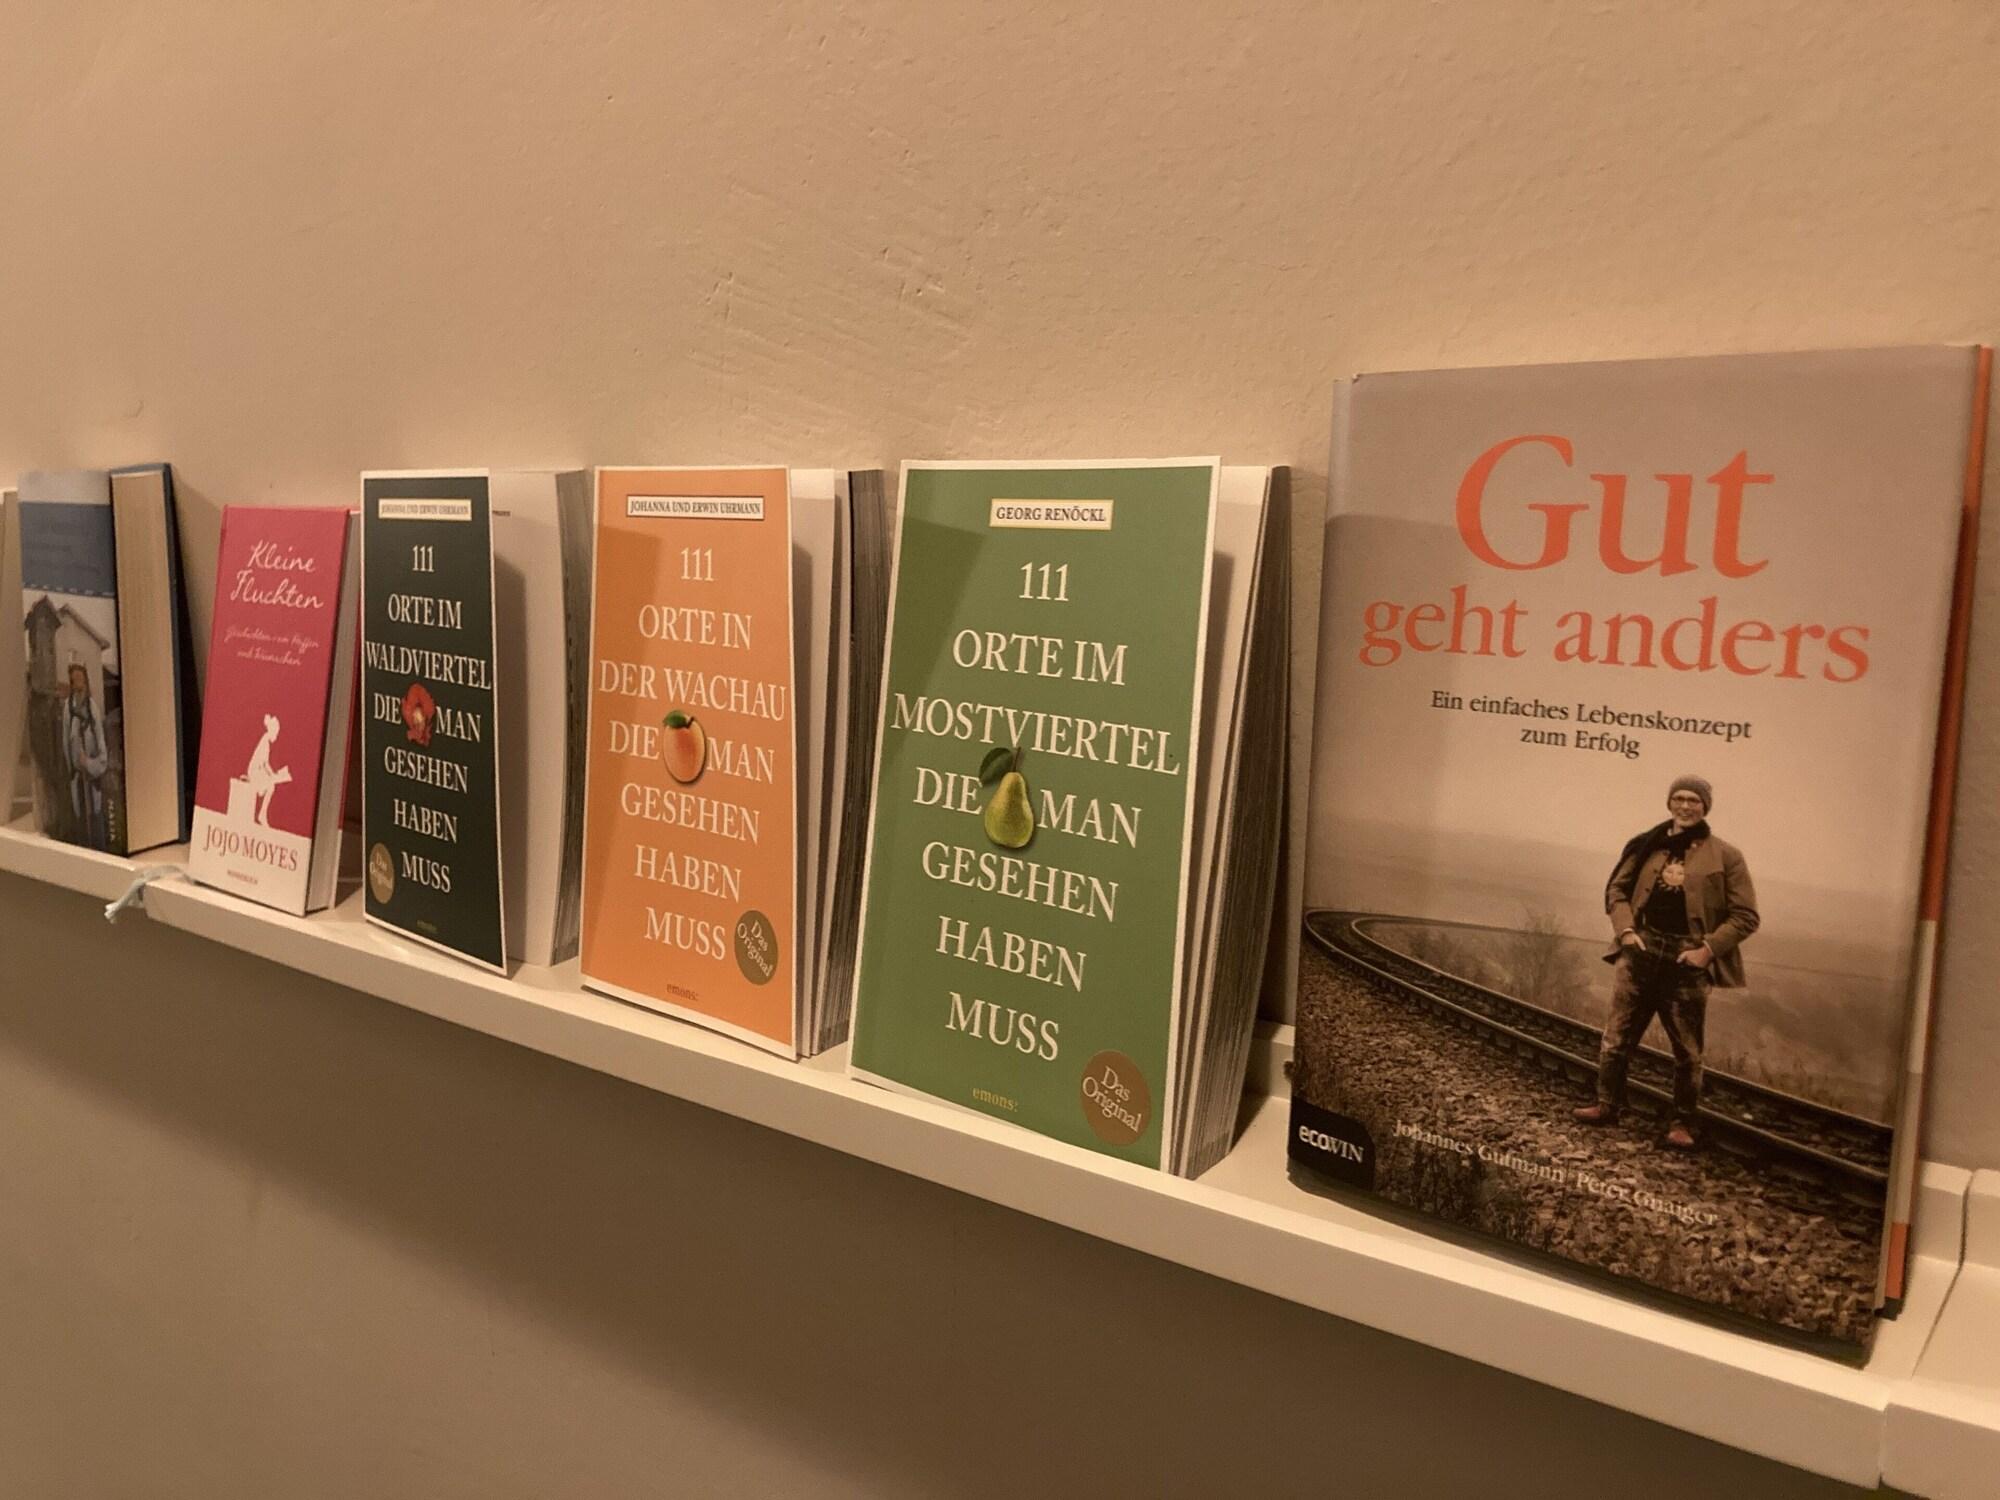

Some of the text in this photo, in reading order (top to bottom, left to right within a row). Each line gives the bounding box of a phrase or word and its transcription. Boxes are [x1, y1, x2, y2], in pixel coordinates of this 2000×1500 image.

[630, 500, 671, 513] JOHANNA
[672, 501, 691, 513] UND
[692, 501, 719, 514] ERWIN
[995, 505, 1107, 522] GEORG RENÖCKL
[1455, 434, 1775, 580] Gut
[247, 539, 316, 572] Kleine
[412, 545, 434, 573] 111
[680, 547, 714, 582] 111
[1019, 561, 1069, 602] 111
[388, 593, 463, 629] ORTE IM
[638, 604, 752, 650] ORTE IN
[1358, 584, 1870, 683] geht anders
[365, 641, 491, 690] WALDVIERTEL
[952, 629, 1128, 686] ORTE IM
[599, 660, 787, 721] DER WACHAU
[374, 692, 481, 742] DIE MAN
[891, 693, 1181, 776] MOSTVIERTEL
[1431, 690, 1752, 743] Ein einfaches Lebenskonzept
[608, 720, 776, 784] DIE MAN
[1520, 727, 1640, 760] zum Erfolg
[384, 745, 469, 794] GESEHEN
[394, 798, 458, 843] HABEN
[620, 782, 760, 845] GESEHEN
[913, 766, 1142, 848] DIE MAN
[202, 824, 298, 872] JOJO MOYES
[401, 851, 451, 893] MUSS
[633, 844, 742, 903] HABEN
[921, 841, 1119, 923] GESEHEN
[644, 906, 726, 961] MUSS
[737, 922, 774, 977] Original
[751, 920, 769, 952] Das
[936, 915, 1087, 993] HABEN
[945, 991, 1060, 1062] MUSS
[1082, 1076, 1142, 1133] Original
[1101, 1065, 1131, 1102] Das
[1392, 1119, 1474, 1156] Johannes
